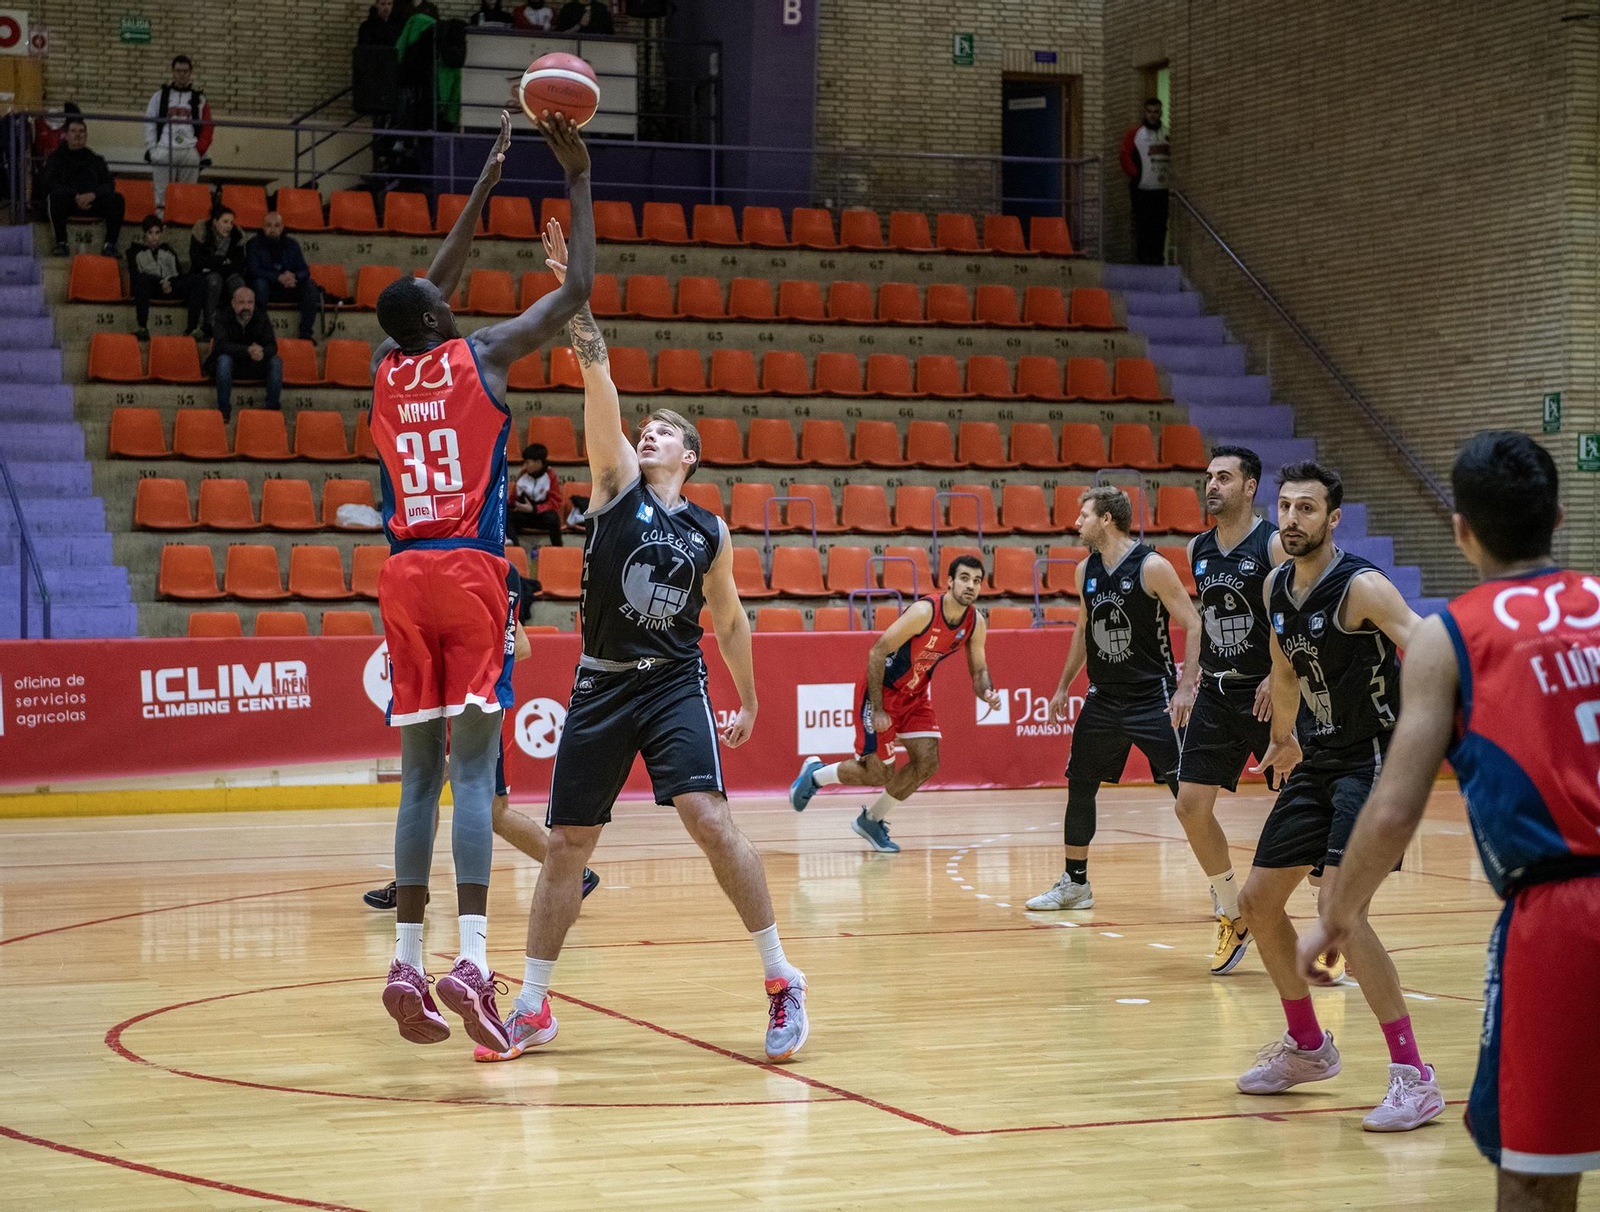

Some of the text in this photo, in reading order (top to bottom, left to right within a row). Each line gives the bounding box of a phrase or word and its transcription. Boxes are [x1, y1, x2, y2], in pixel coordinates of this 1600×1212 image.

[783, 0, 802, 25] B
[116, 393, 135, 405] 52
[177, 394, 195, 406] 53
[237, 395, 255, 407] 54
[296, 397, 313, 409] 55
[353, 398, 370, 409] 56
[397, 399, 446, 424] MAYOT
[525, 400, 542, 412] 59
[636, 403, 651, 414] 61
[688, 404, 704, 416] 62
[742, 405, 758, 416] 63
[795, 406, 811, 417] 64
[847, 407, 863, 418] 65
[899, 407, 915, 418] 66
[948, 408, 963, 420] 67
[998, 410, 1013, 421] 68
[1049, 410, 1064, 421] 69
[1100, 410, 1115, 422] 70
[1148, 410, 1162, 422] 71
[396, 428, 463, 494] 33
[408, 507, 430, 517] UNED
[641, 529, 696, 558] COLEGIO
[671, 556, 685, 578] 7
[1199, 572, 1245, 591] COLEGIO
[1223, 592, 1237, 611] 8
[618, 602, 675, 632] EL PINAR
[1209, 638, 1254, 658] EL PINAR
[1097, 647, 1135, 664] EL PINAR
[1530, 642, 1600, 695] F. LÓP
[14, 673, 85, 690] oficina de
[15, 691, 86, 708] servicios
[142, 694, 311, 719] CLIMBING CENTER
[805, 709, 853, 728] UNED
[1017, 723, 1060, 737] PARAÍSO
